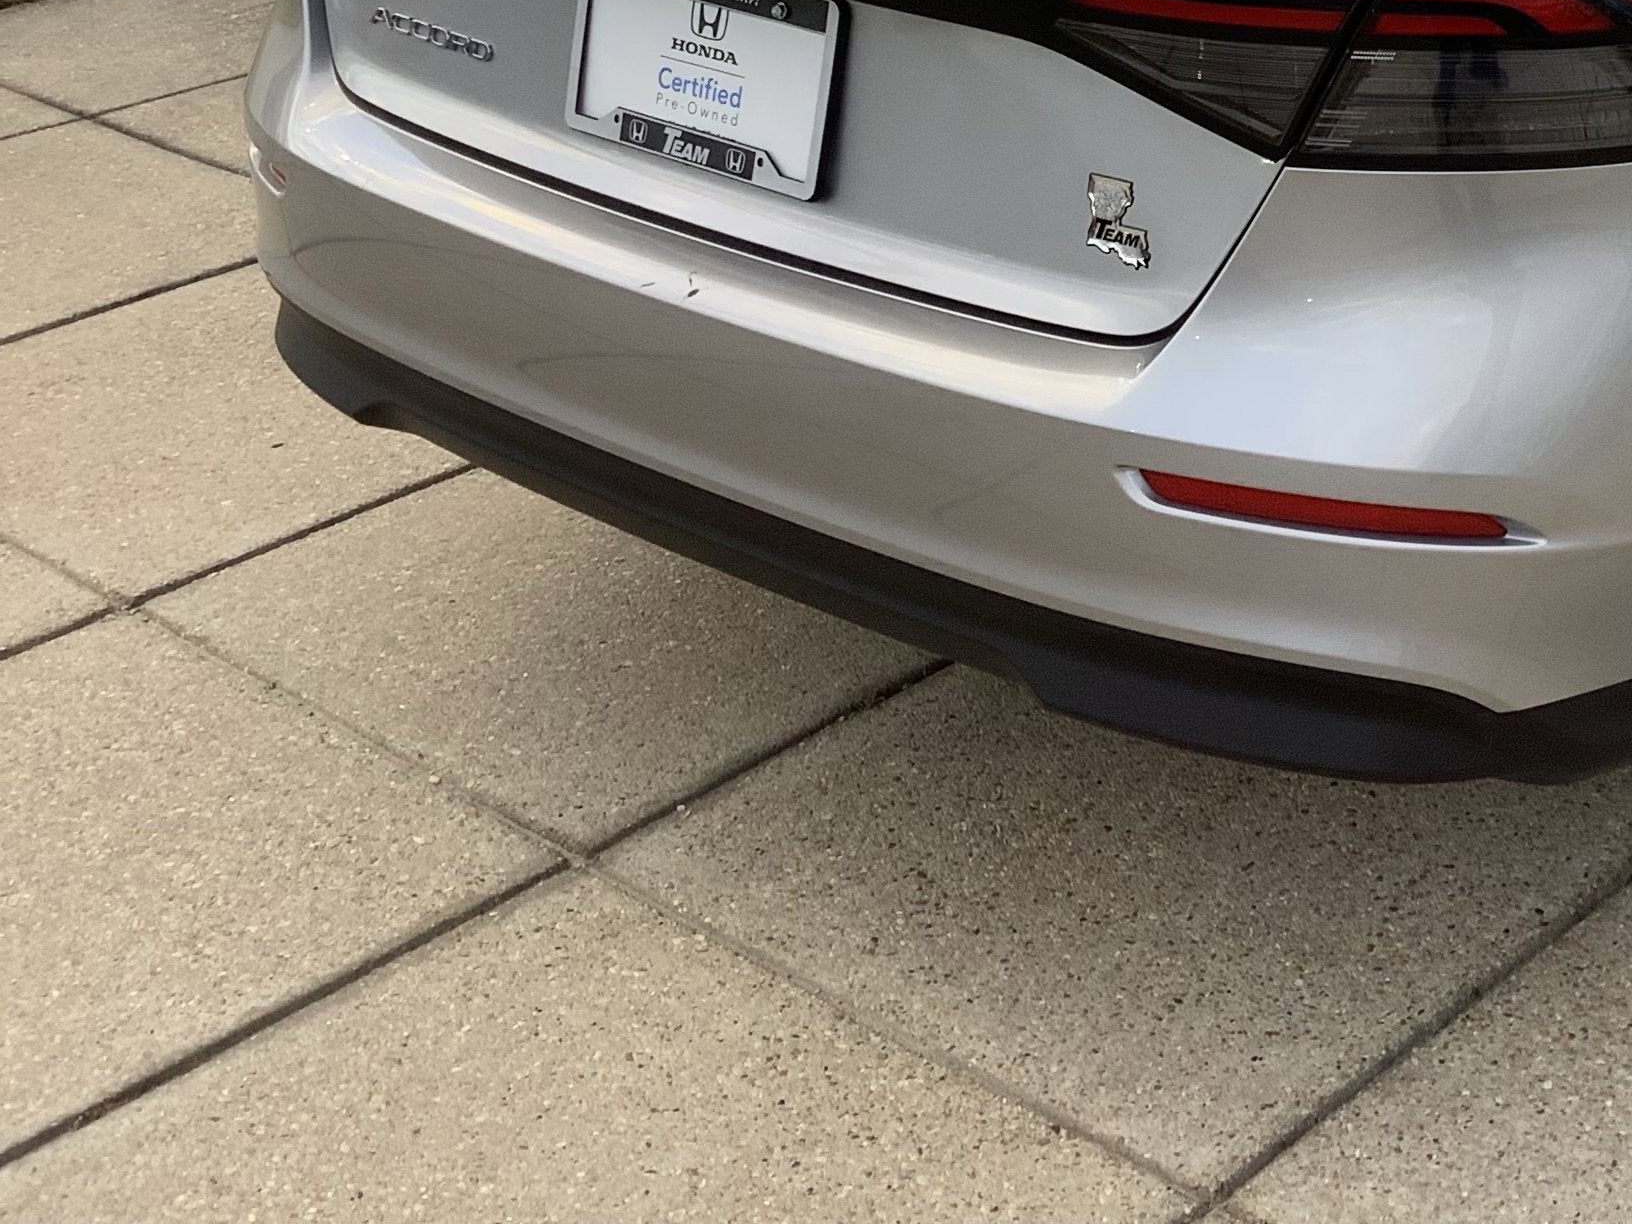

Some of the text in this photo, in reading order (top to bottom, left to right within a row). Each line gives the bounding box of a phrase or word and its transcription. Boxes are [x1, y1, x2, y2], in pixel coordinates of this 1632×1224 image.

[370, 6, 495, 62] ACCORD
[670, 37, 738, 66] HONDA
[658, 66, 743, 109] Certified
[655, 92, 740, 127] Pre-Owned
[661, 126, 711, 166] TEAM
[1095, 217, 1141, 248] TEAM
